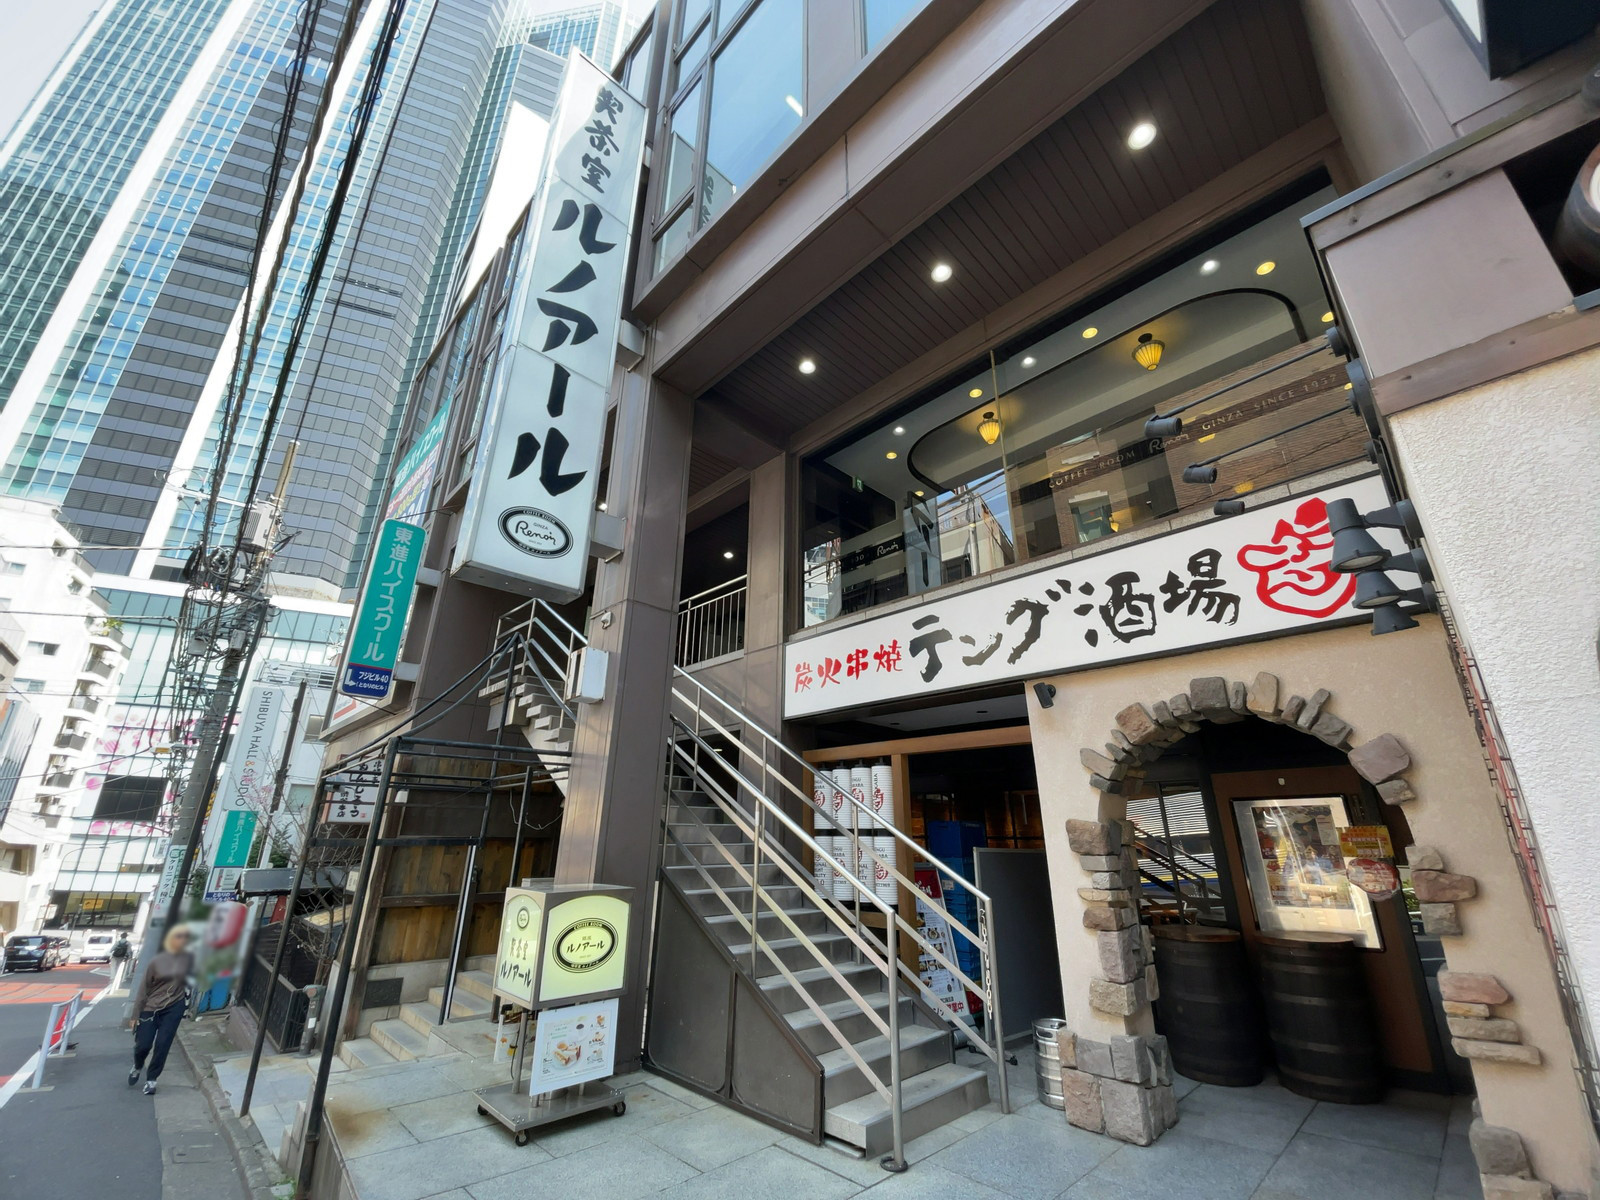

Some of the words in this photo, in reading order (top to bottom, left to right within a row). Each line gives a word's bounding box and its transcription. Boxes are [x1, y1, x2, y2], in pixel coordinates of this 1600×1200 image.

[507, 199, 617, 497] ルノアール
[1099, 449, 1136, 470] ROOM
[1202, 410, 1244, 431] GINZA
[1254, 389, 1296, 411] SINCE
[515, 520, 557, 545] Renoir
[363, 527, 412, 661] 東進ハイスクール
[908, 548, 1240, 683] テング酒場
[794, 639, 903, 694] 炭火串焼
[252, 690, 273, 733] SHIBUYA
[245, 736, 261, 759] HALL
[566, 940, 605, 955] ルノアール
[500, 960, 531, 987] ルノアール
